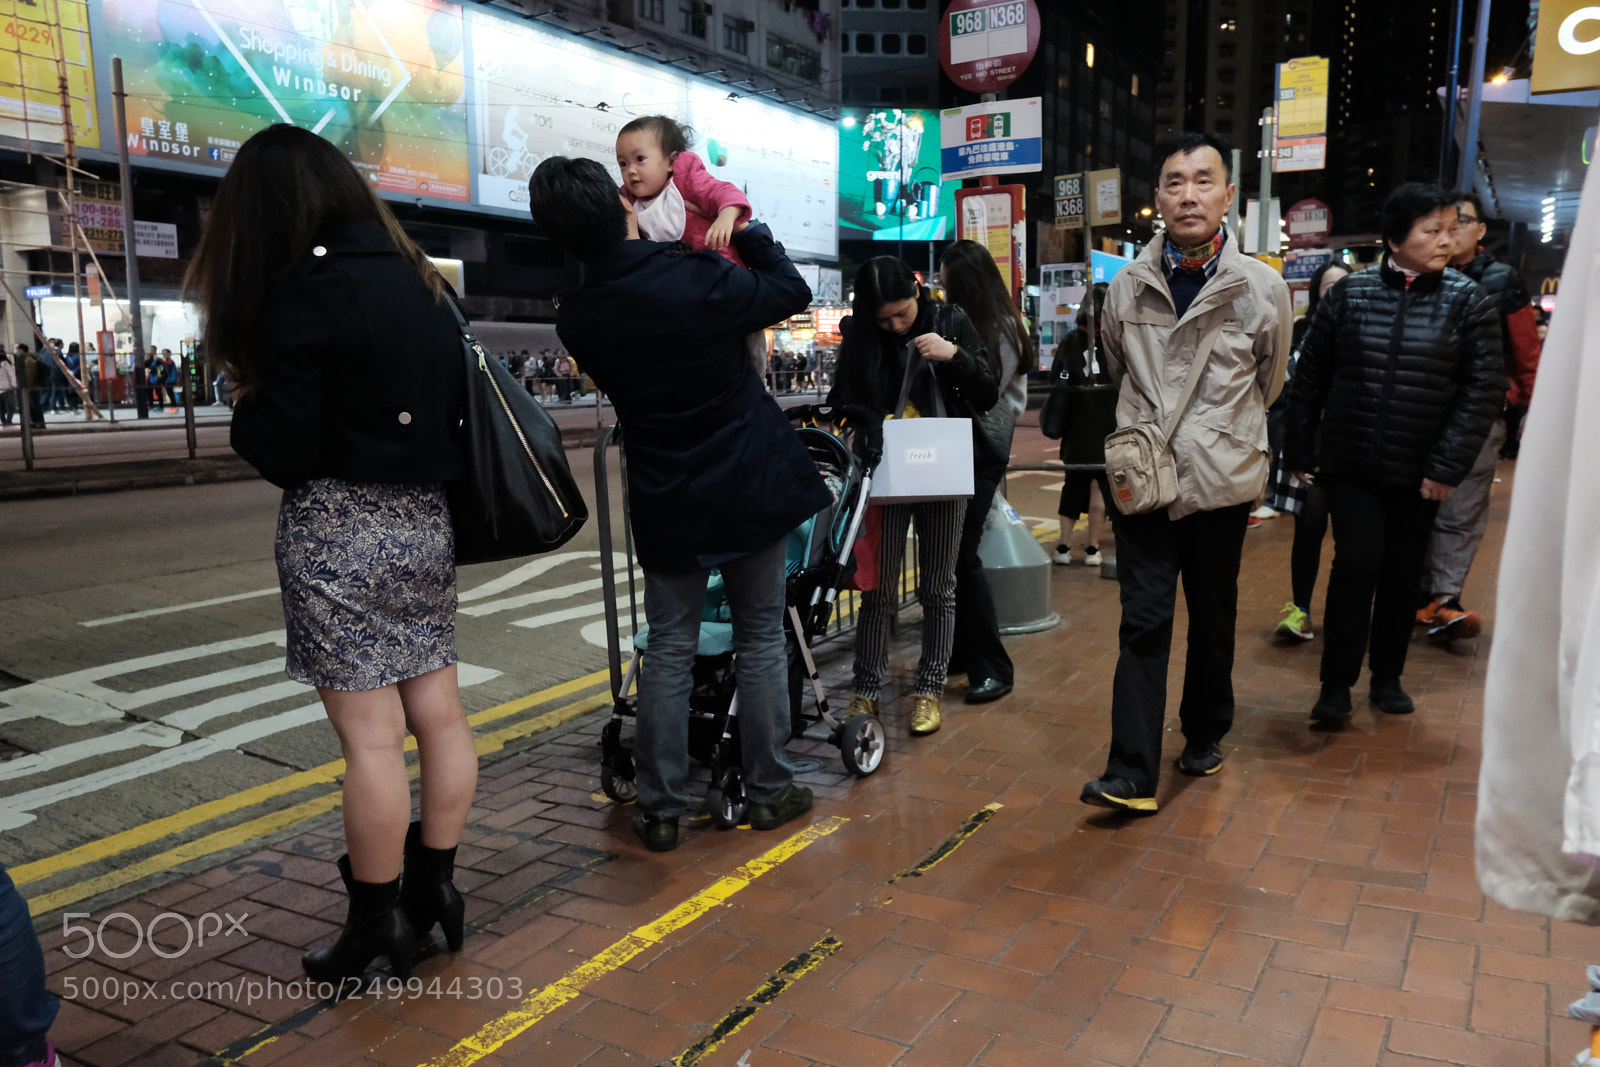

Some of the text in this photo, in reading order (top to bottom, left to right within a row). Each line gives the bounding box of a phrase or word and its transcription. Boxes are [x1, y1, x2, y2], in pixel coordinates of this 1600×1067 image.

[957, 3, 1025, 34] 968 N368
[4, 22, 52, 45] 4229
[239, 26, 391, 87] Shopping & Dining
[960, 73, 972, 81] YEE
[990, 66, 1016, 76] STREET
[140, 116, 190, 143] 皇室堡
[1059, 179, 1080, 197] 968
[1056, 198, 1084, 217] N368
[909, 450, 933, 461] fresh
